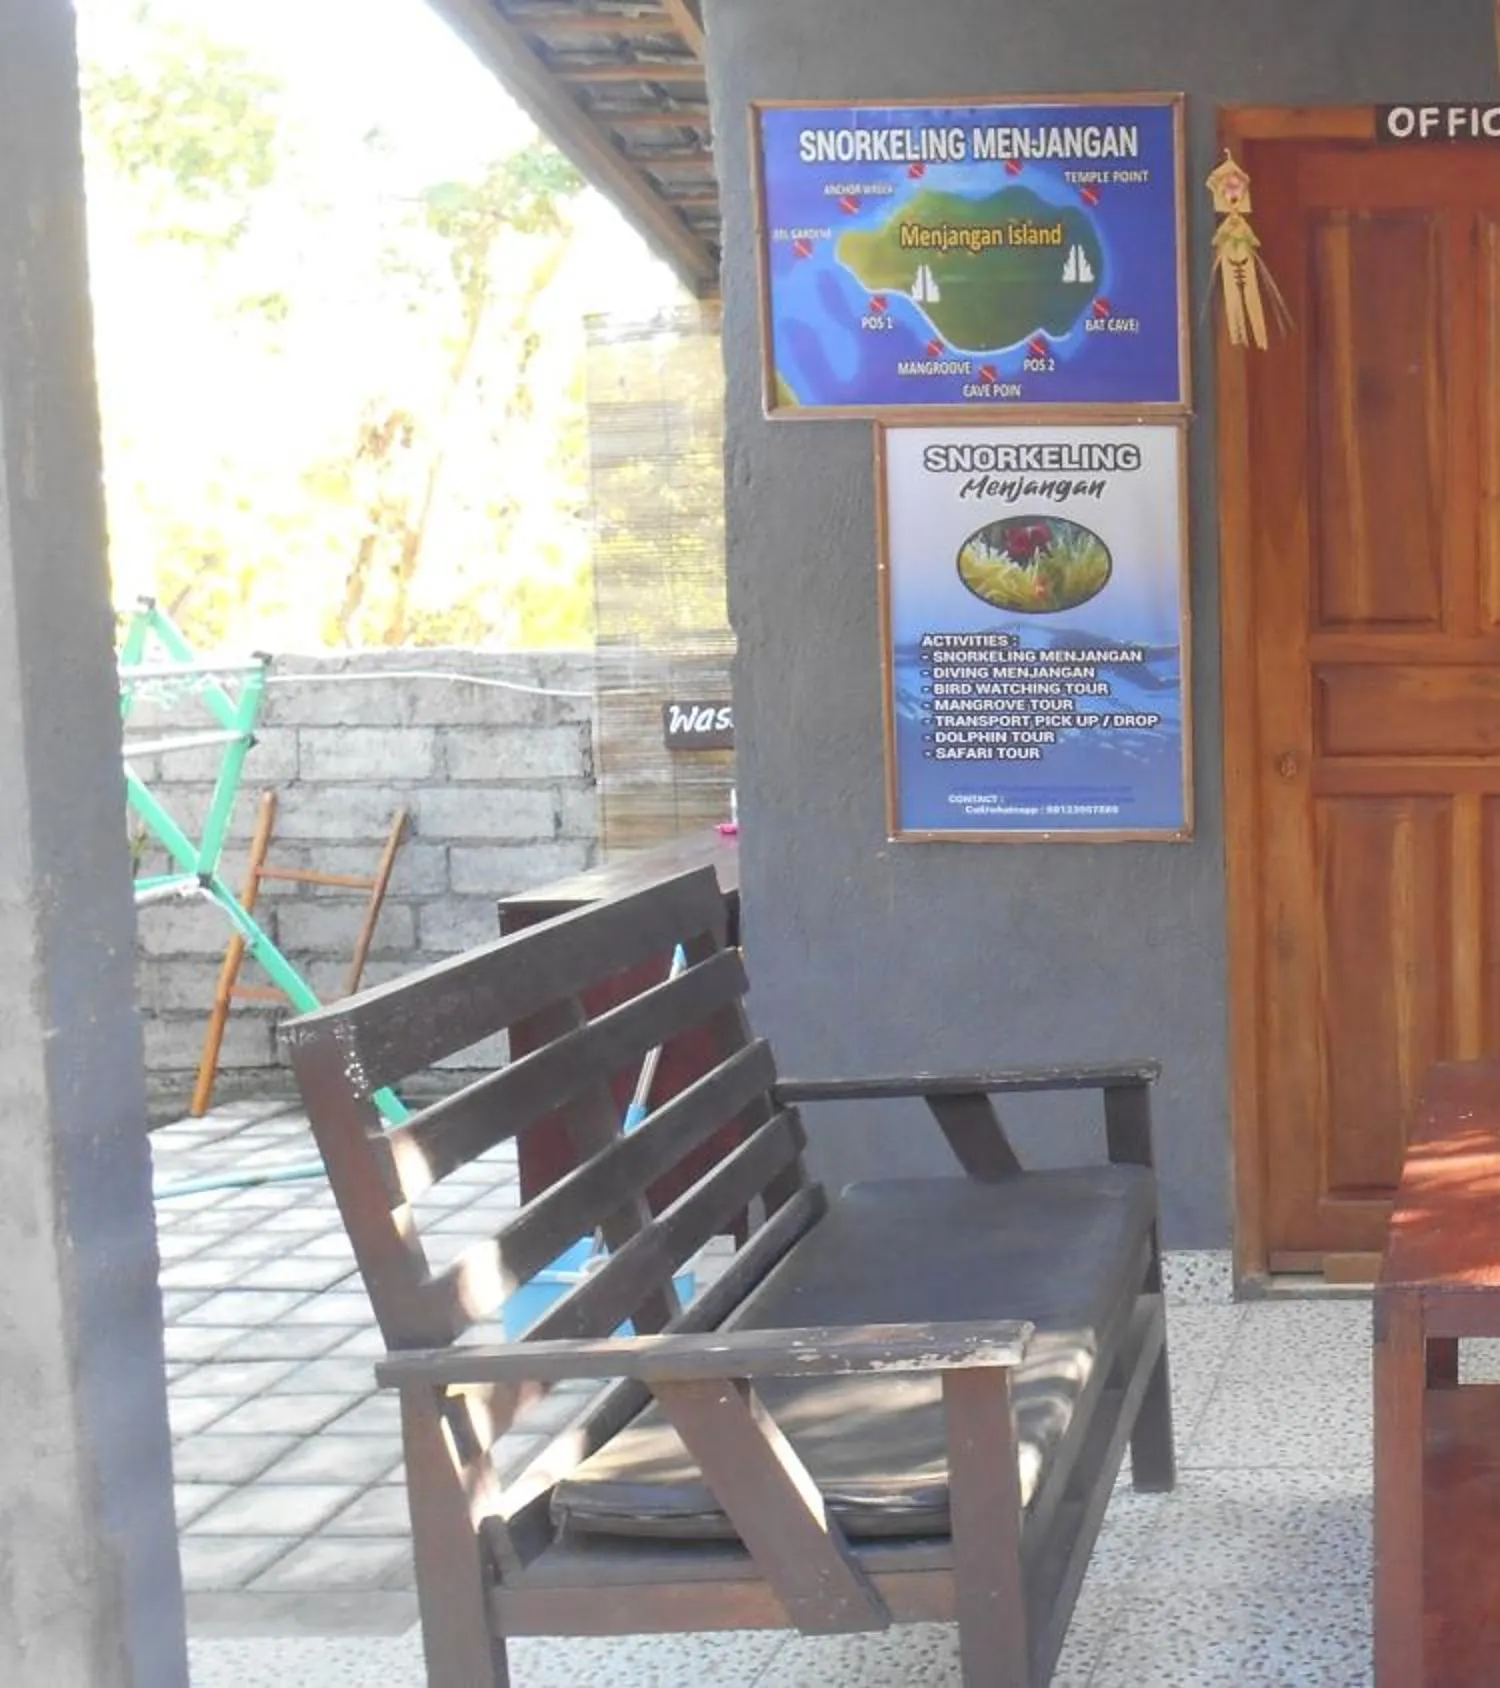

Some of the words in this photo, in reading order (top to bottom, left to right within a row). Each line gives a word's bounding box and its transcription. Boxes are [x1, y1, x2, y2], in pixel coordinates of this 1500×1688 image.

[800, 128, 966, 162] SNORKELING
[973, 126, 1138, 160] MENJANGAN
[1064, 170, 1110, 183] TEMPLE
[1113, 170, 1149, 183] POINT
[900, 224, 1003, 252] Menjangan
[1008, 222, 1062, 246] Island
[862, 317, 884, 329] POS
[886, 316, 893, 329] 1
[897, 362, 972, 375] MANGROOVE
[1023, 359, 1046, 371] POS
[1047, 359, 1055, 371] 2
[924, 444, 1140, 471] SNORKELING
[960, 474, 1107, 502] Menjangan
[922, 635, 1009, 647] ACTIVITIES
[933, 650, 1036, 662] SNORKELING
[1039, 650, 1142, 662] MENJANGAN
[933, 667, 989, 679] DIVING
[992, 667, 1095, 678] MENJANGAN
[933, 683, 972, 695] BIRD
[976, 683, 1061, 695] WATCHING
[1065, 683, 1109, 694] TOUR
[935, 700, 1024, 711] MANGROVE
[1030, 700, 1073, 711] TOUR
[668, 705, 734, 734] Was
[935, 716, 1030, 727] TRANSPORT
[1035, 716, 1073, 727] PICK
[1076, 716, 1098, 727] UP
[1113, 716, 1158, 727] DROP
[935, 732, 1007, 743] DOLPHIN
[1012, 732, 1055, 743] TOUR
[935, 748, 992, 759] SAFARI
[997, 748, 1040, 759] TOUR
